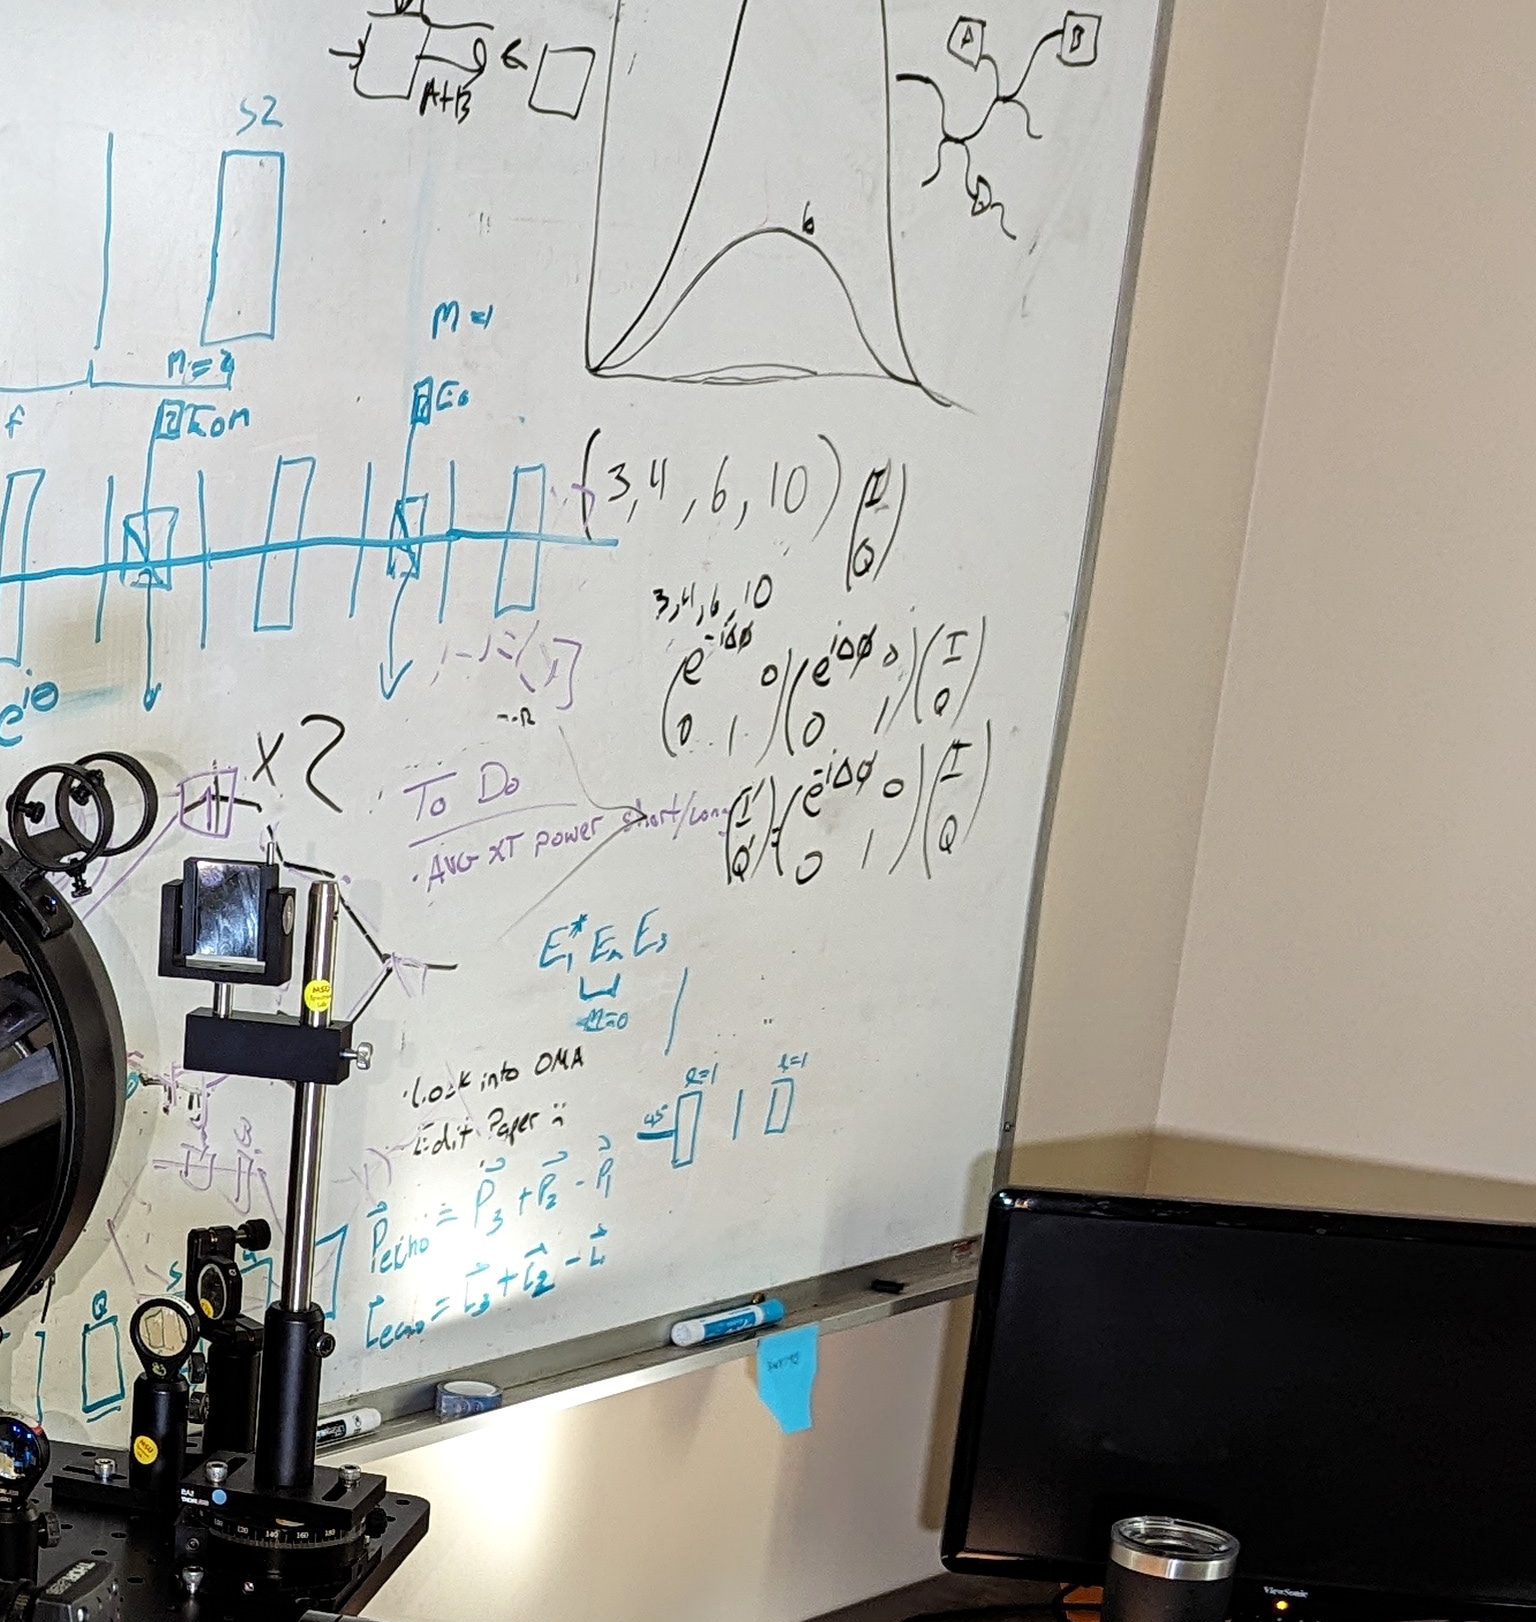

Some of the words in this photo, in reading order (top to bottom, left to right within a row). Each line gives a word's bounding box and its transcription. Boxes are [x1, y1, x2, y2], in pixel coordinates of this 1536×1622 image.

[403, 771, 458, 822] To
[477, 761, 520, 804] Do
[534, 815, 605, 859] power
[479, 1062, 521, 1091] into
[296, 1531, 310, 1540] 160
[1263, 1586, 1309, 1599] ViewSonic
